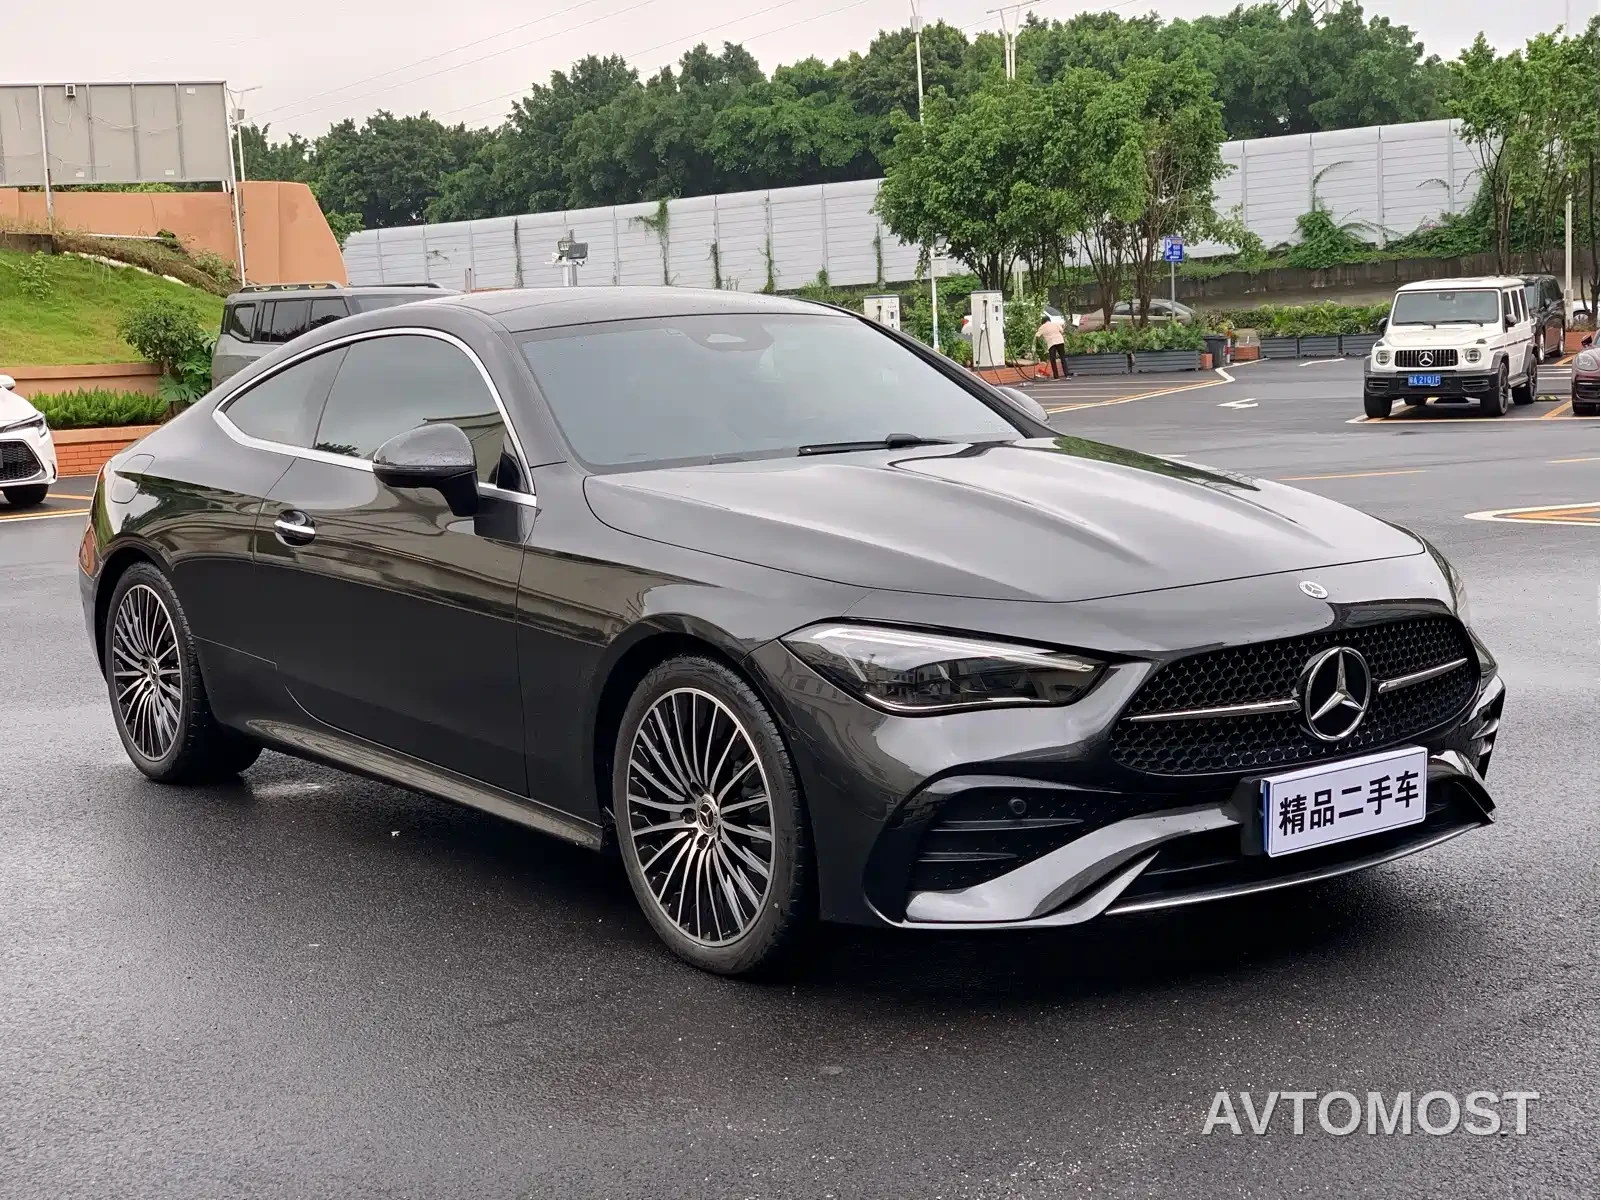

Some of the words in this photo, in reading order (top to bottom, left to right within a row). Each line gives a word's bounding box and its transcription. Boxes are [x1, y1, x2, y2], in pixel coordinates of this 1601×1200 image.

[1278, 770, 1419, 836] 精品二手车
